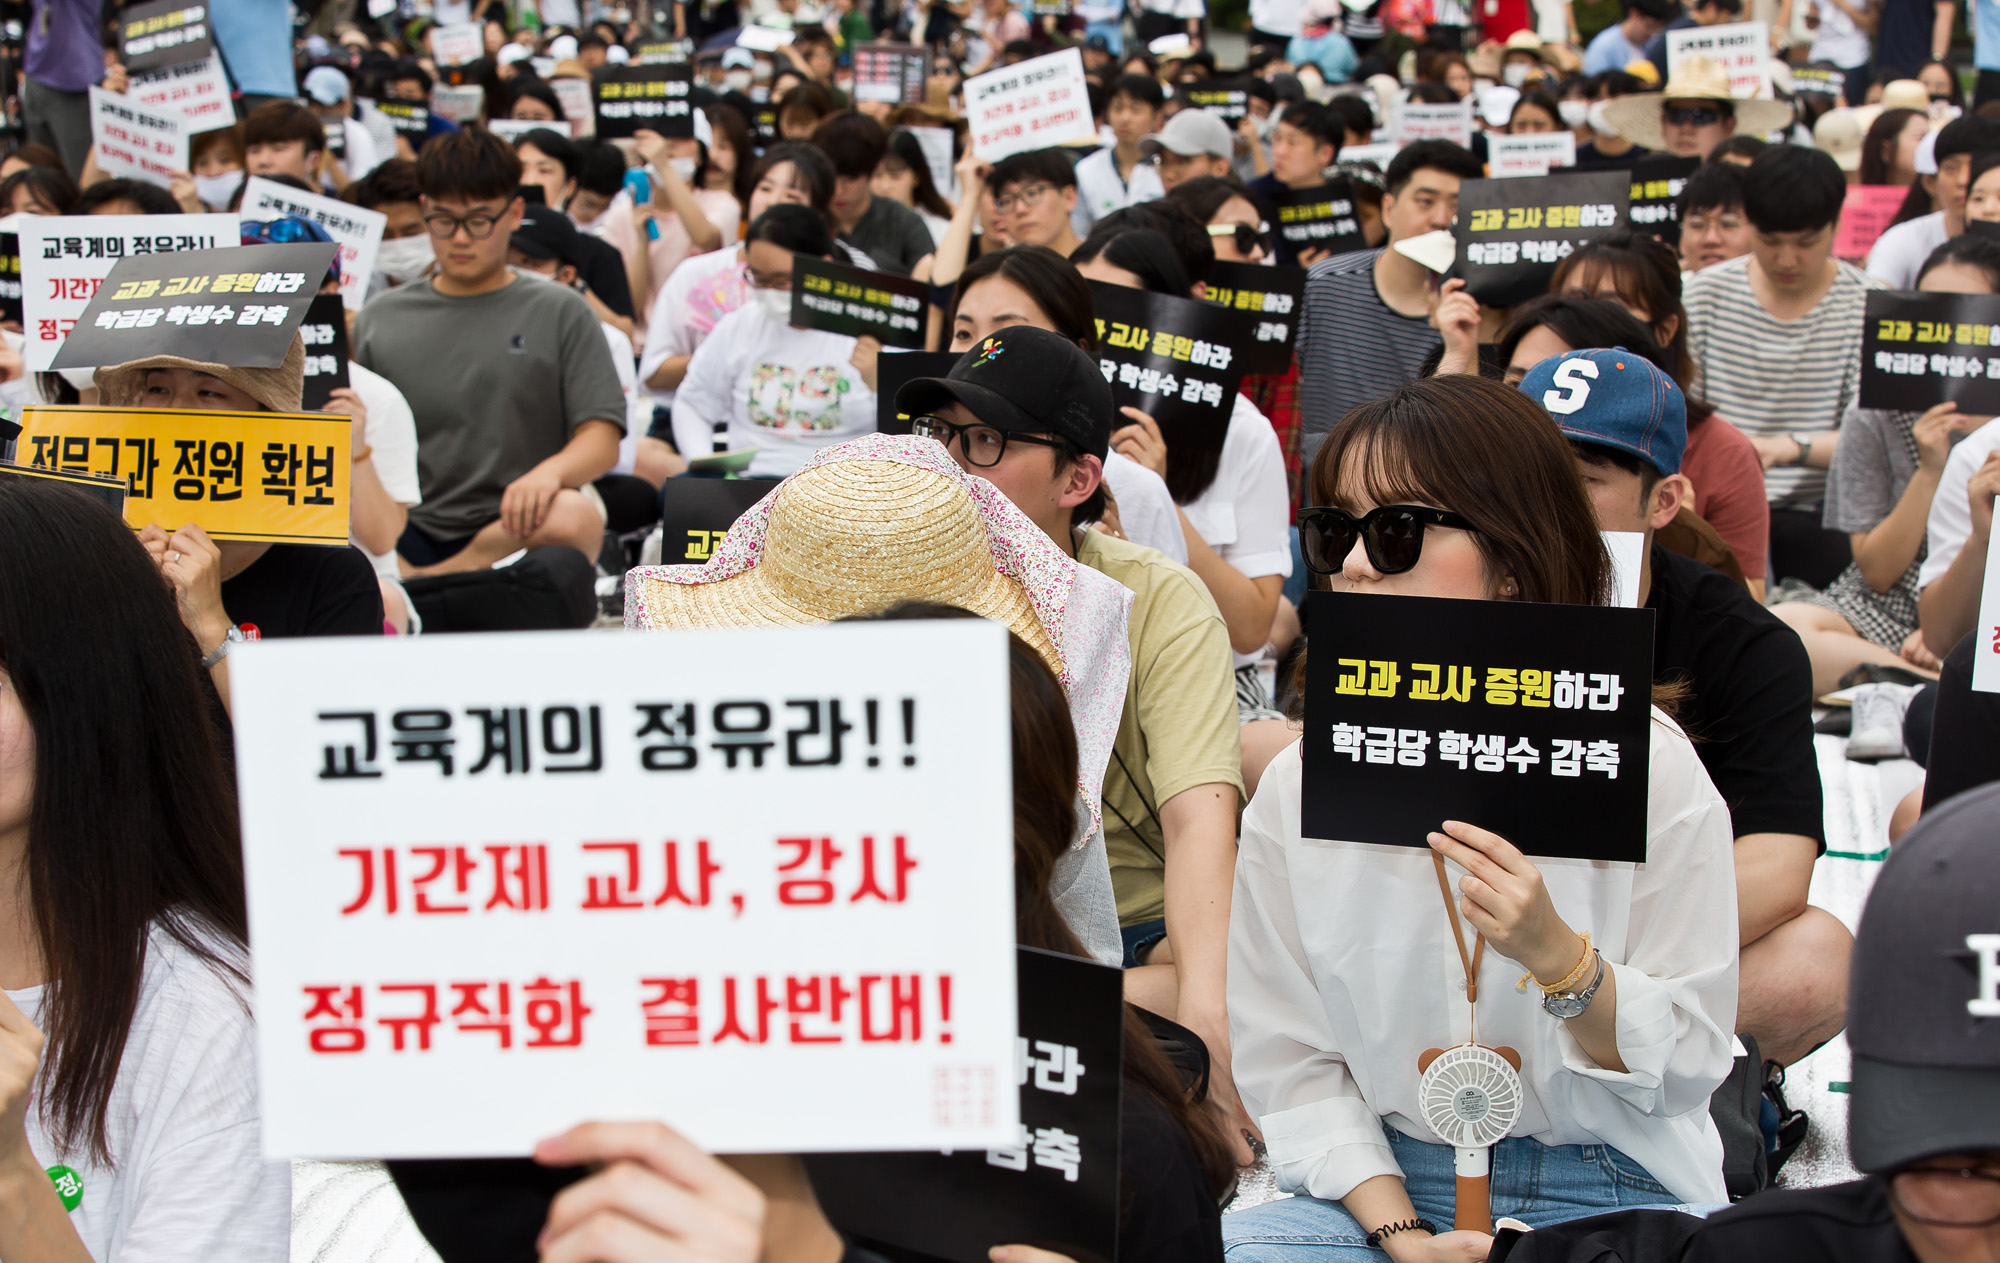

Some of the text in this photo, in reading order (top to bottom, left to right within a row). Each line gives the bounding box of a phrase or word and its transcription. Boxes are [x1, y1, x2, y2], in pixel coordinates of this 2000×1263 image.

[1469, 203, 1617, 231] 교과 교사 증원하라
[42, 236, 126, 259] 교육계의
[1467, 240, 1520, 265] 학급당
[111, 272, 306, 301] 교과 교사 증원하라
[94, 304, 290, 330] 학급당 학생수 감축
[1877, 319, 1915, 342] 교과
[1915, 321, 1953, 344] 교사
[1106, 321, 1150, 352] 교사
[1151, 331, 1233, 371] 증원하라
[1875, 350, 1929, 375] 학급당
[1930, 353, 1985, 378] 학생수
[1118, 362, 1180, 398] 학생수
[1181, 376, 1224, 408] 감축
[1543, 357, 1600, 415] S
[173, 438, 244, 502] 정원
[261, 442, 335, 506] 확보
[1334, 658, 1625, 712] 교과 교사 증원하라
[315, 698, 919, 781] 교육계의 정유라!!
[1332, 722, 1621, 780] 학급당 학생수 감축
[337, 833, 920, 920] 기간제 교사, 강사
[301, 973, 956, 1053] 정규직화 결사반대!
